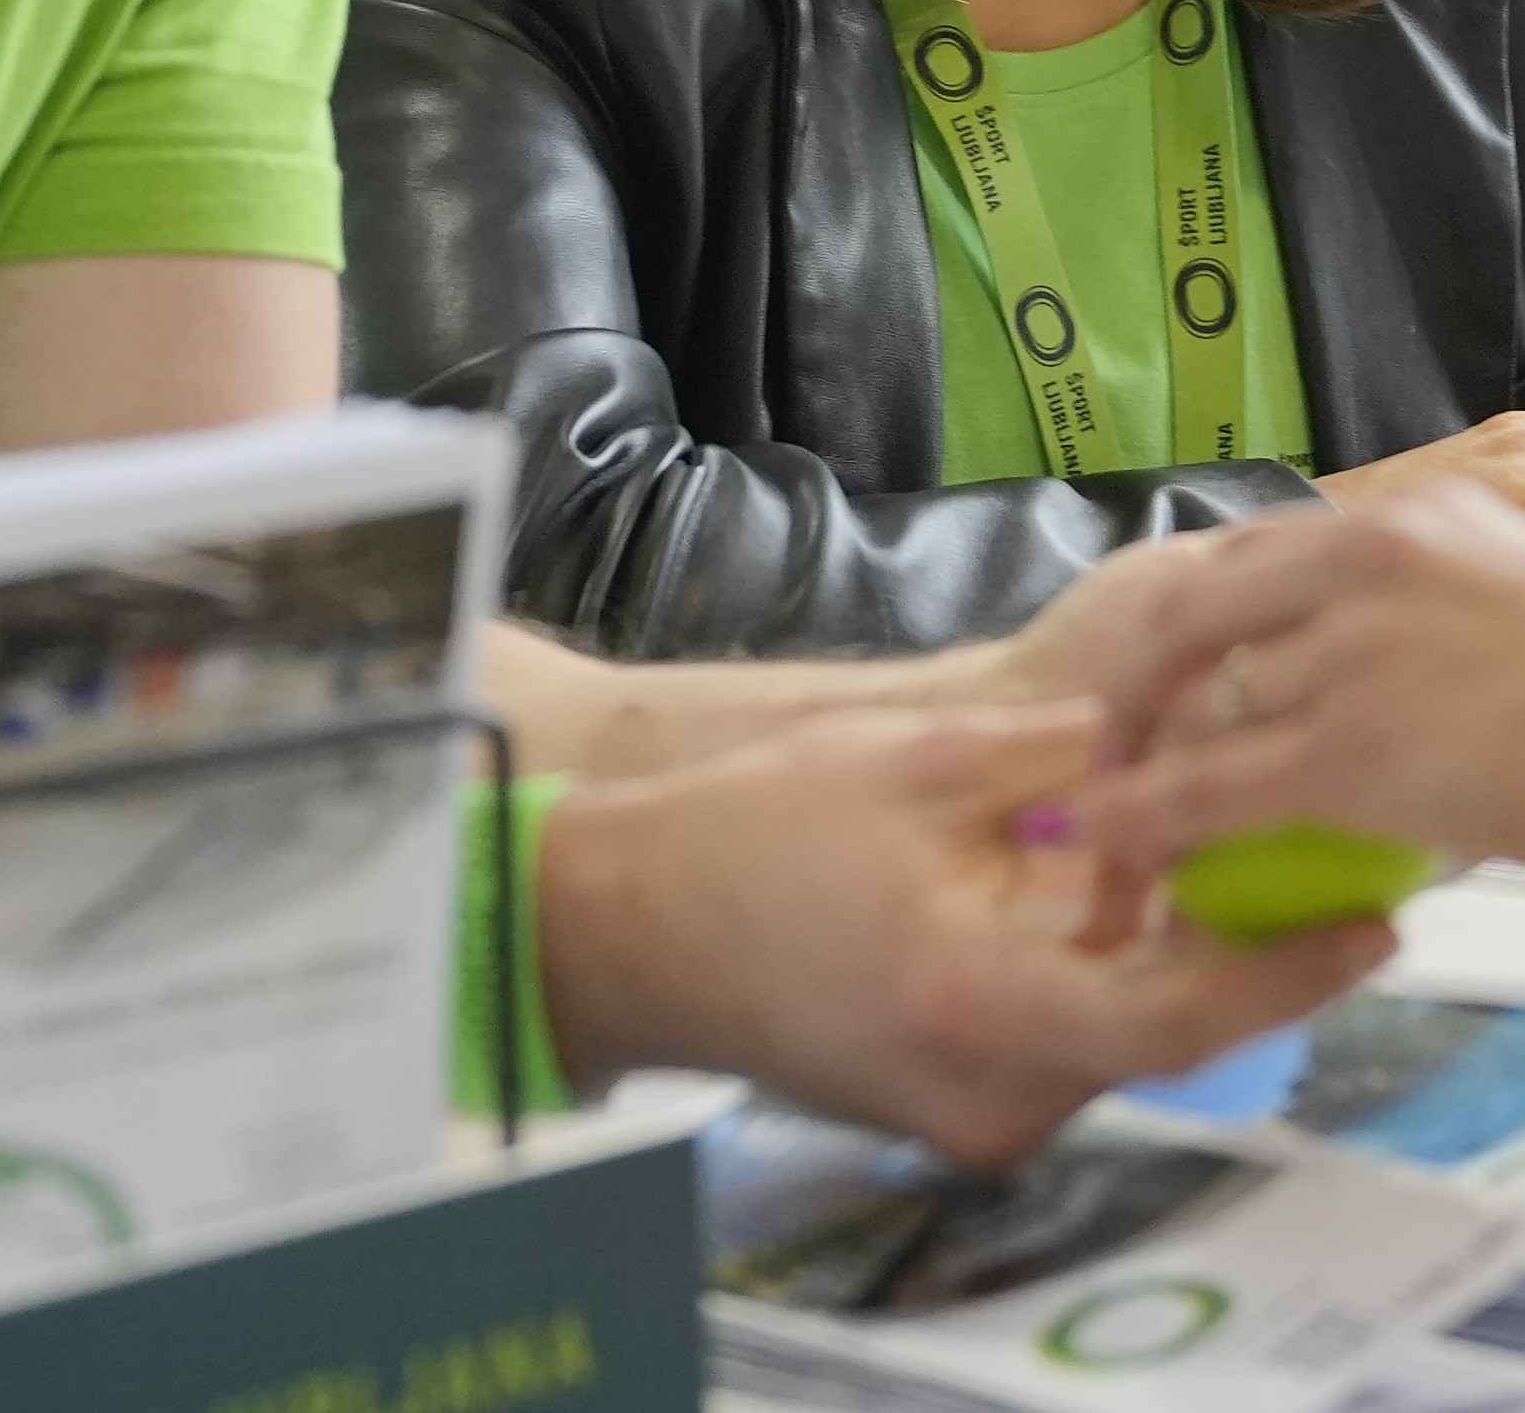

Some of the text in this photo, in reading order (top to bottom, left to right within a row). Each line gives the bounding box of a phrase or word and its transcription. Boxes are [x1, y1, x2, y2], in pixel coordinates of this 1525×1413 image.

[950, 114, 1002, 213] LJUBLJANA
[975, 104, 1013, 164] ŠPORT
[1178, 186, 1200, 247] ŠPORT
[1202, 142, 1229, 245] LJUBLJANA
[1065, 372, 1097, 432] ŠPORT
